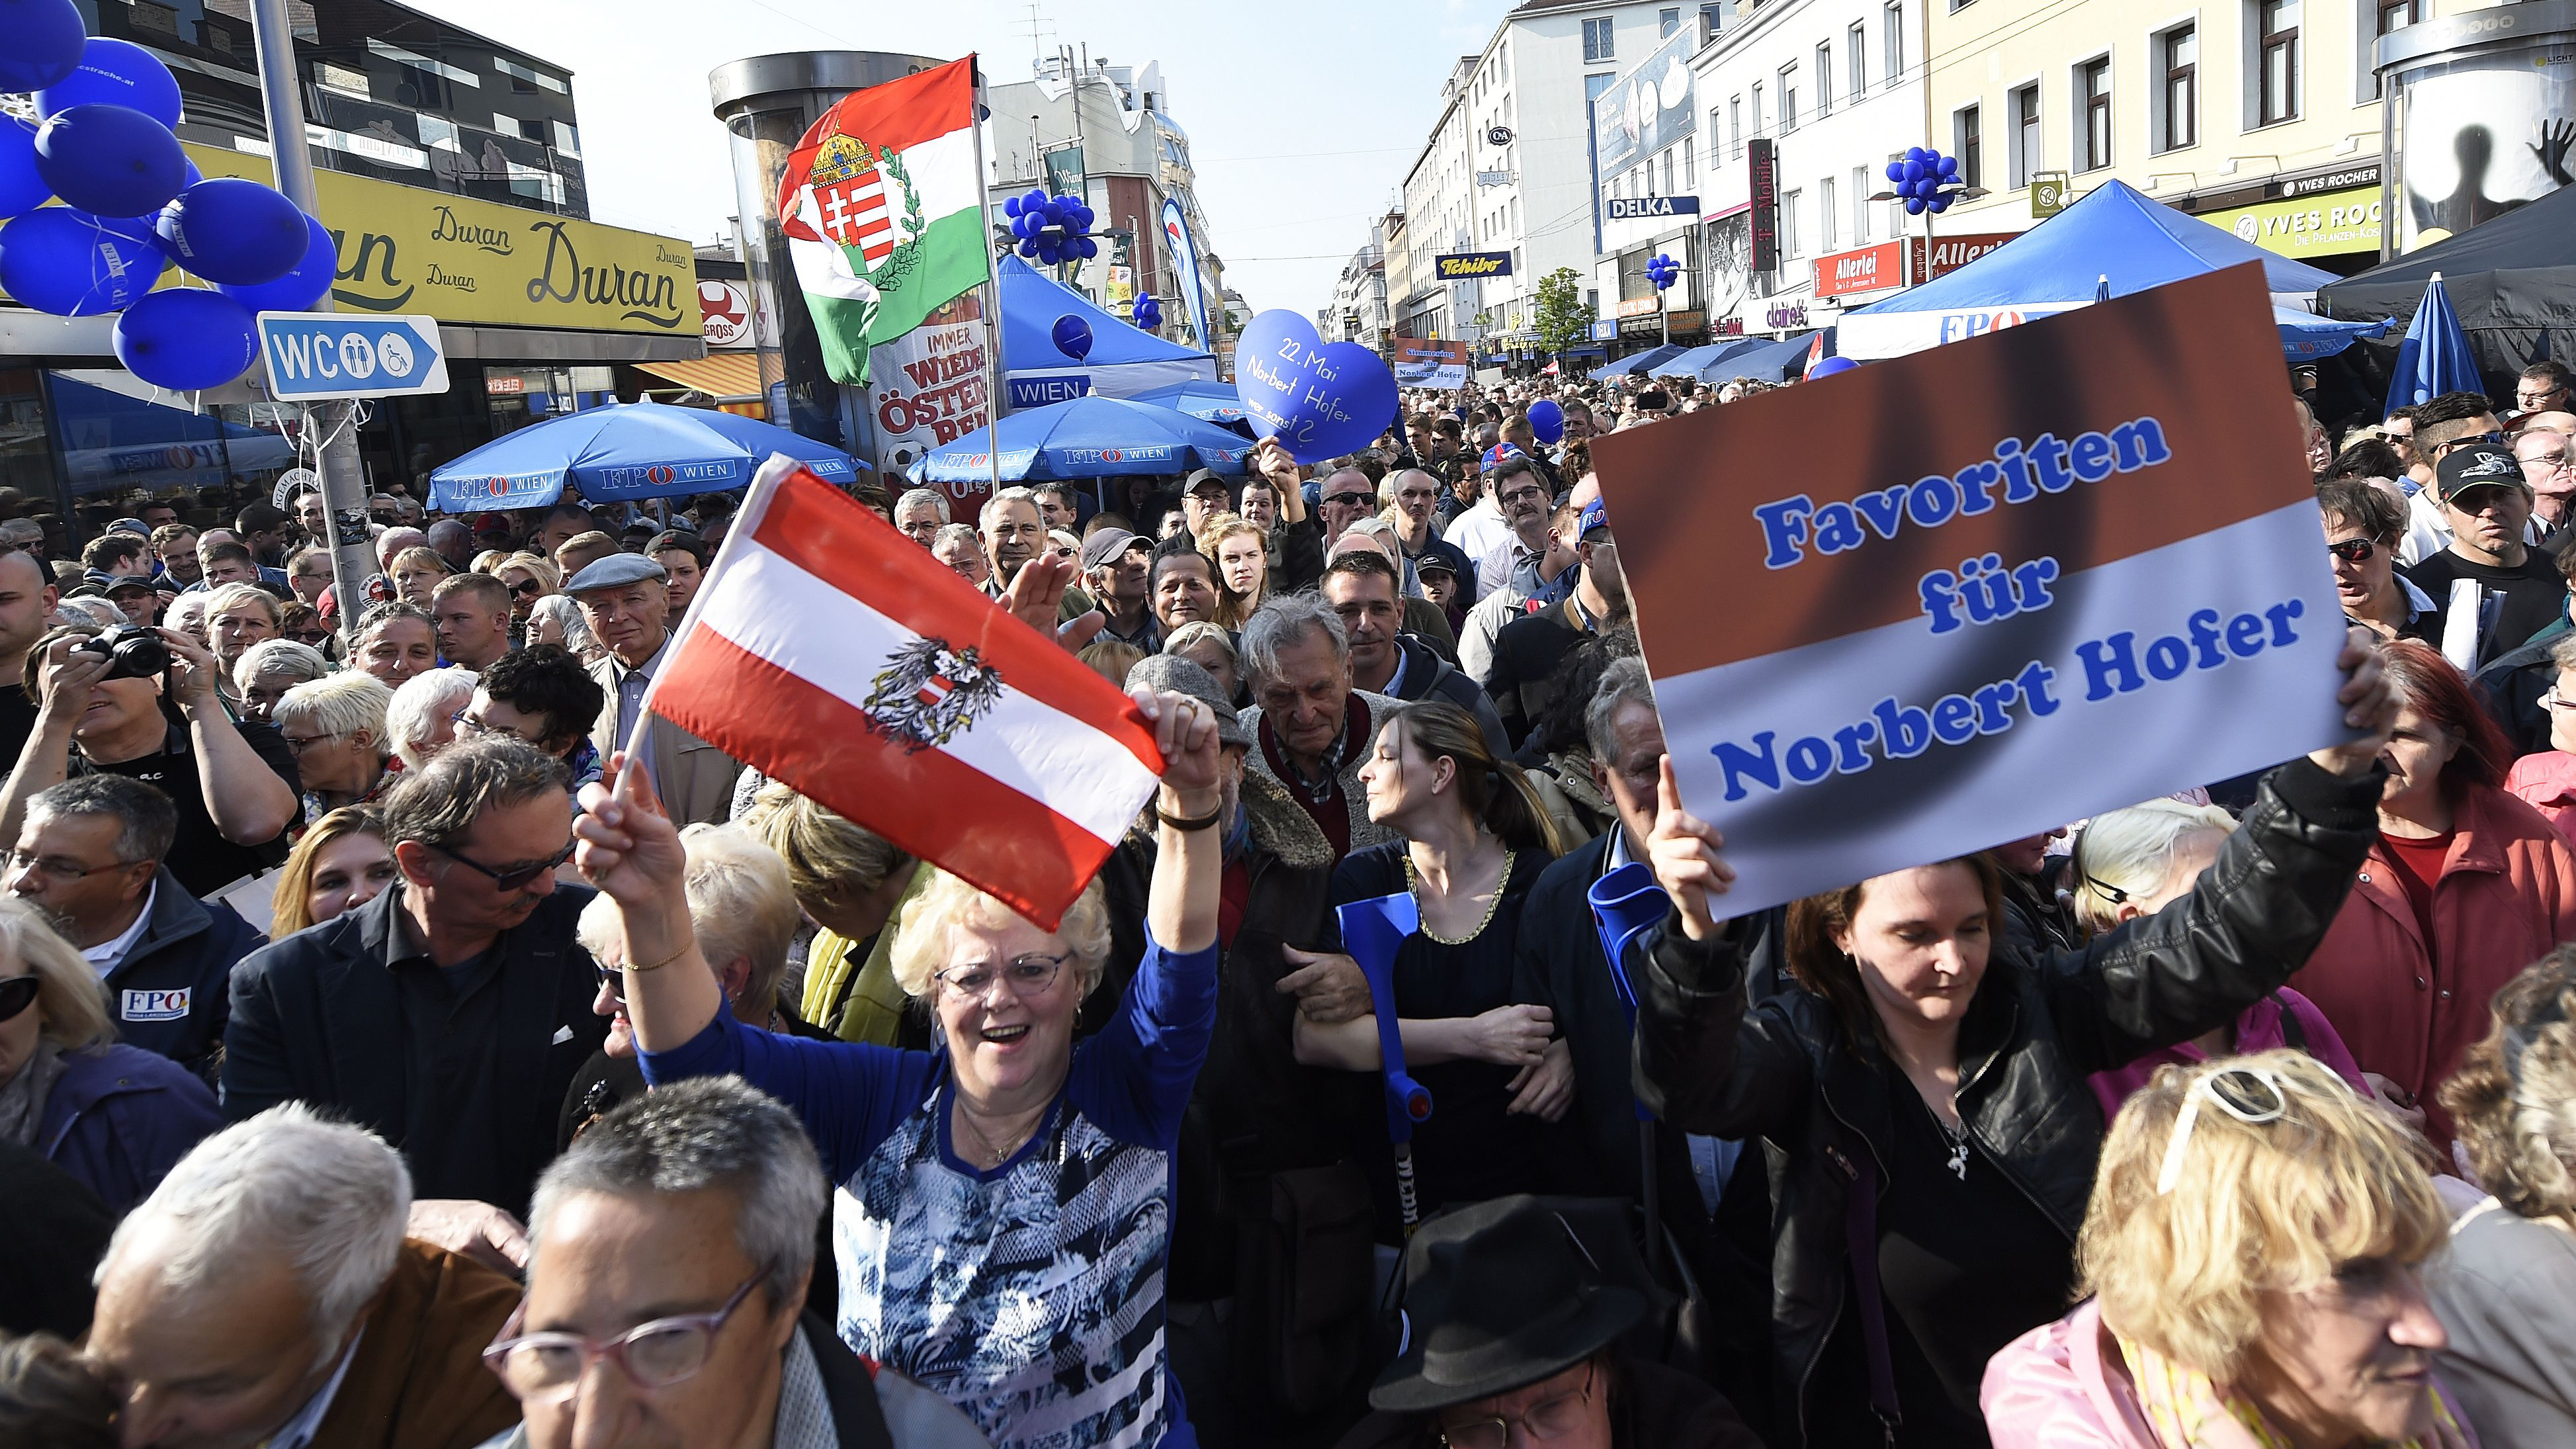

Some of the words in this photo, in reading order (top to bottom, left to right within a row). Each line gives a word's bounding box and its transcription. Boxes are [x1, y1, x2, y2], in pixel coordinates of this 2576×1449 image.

[1482, 173, 1509, 182] SISLEY
[2297, 177, 2325, 192] YVES
[2327, 168, 2378, 187] ROCHER
[1612, 198, 1674, 217] DELKA
[2262, 210, 2321, 236] YVES
[2330, 200, 2382, 228] ROC
[431, 206, 513, 255] Duran
[656, 244, 688, 269] Duran
[1440, 257, 1504, 275] Tchibo
[1835, 251, 1877, 280] Allerlei
[426, 263, 478, 293] Duran
[527, 222, 683, 328] Duran
[704, 324, 734, 339] GROSS
[927, 328, 973, 354] IMMER
[273, 333, 339, 380] WC
[1277, 337, 1301, 365] 22.
[1304, 350, 1340, 382] Mai
[1406, 347, 1455, 359] Simmering
[1399, 369, 1435, 378] Norbert
[1017, 381, 1080, 402] WIEN
[1246, 355, 1298, 396] Norbert
[1304, 385, 1352, 423] Hofer
[1248, 398, 1264, 412] wer
[1265, 414, 1298, 431] sonst
[1129, 449, 1165, 459] WIEN
[683, 464, 727, 478] WIEN
[814, 462, 841, 473] WIEN
[515, 475, 548, 490] WIEN
[1752, 416, 2172, 570] Favoriten
[1918, 553, 2060, 635] für
[1710, 660, 2060, 802] Norbert
[2075, 597, 2305, 703] Hofer
